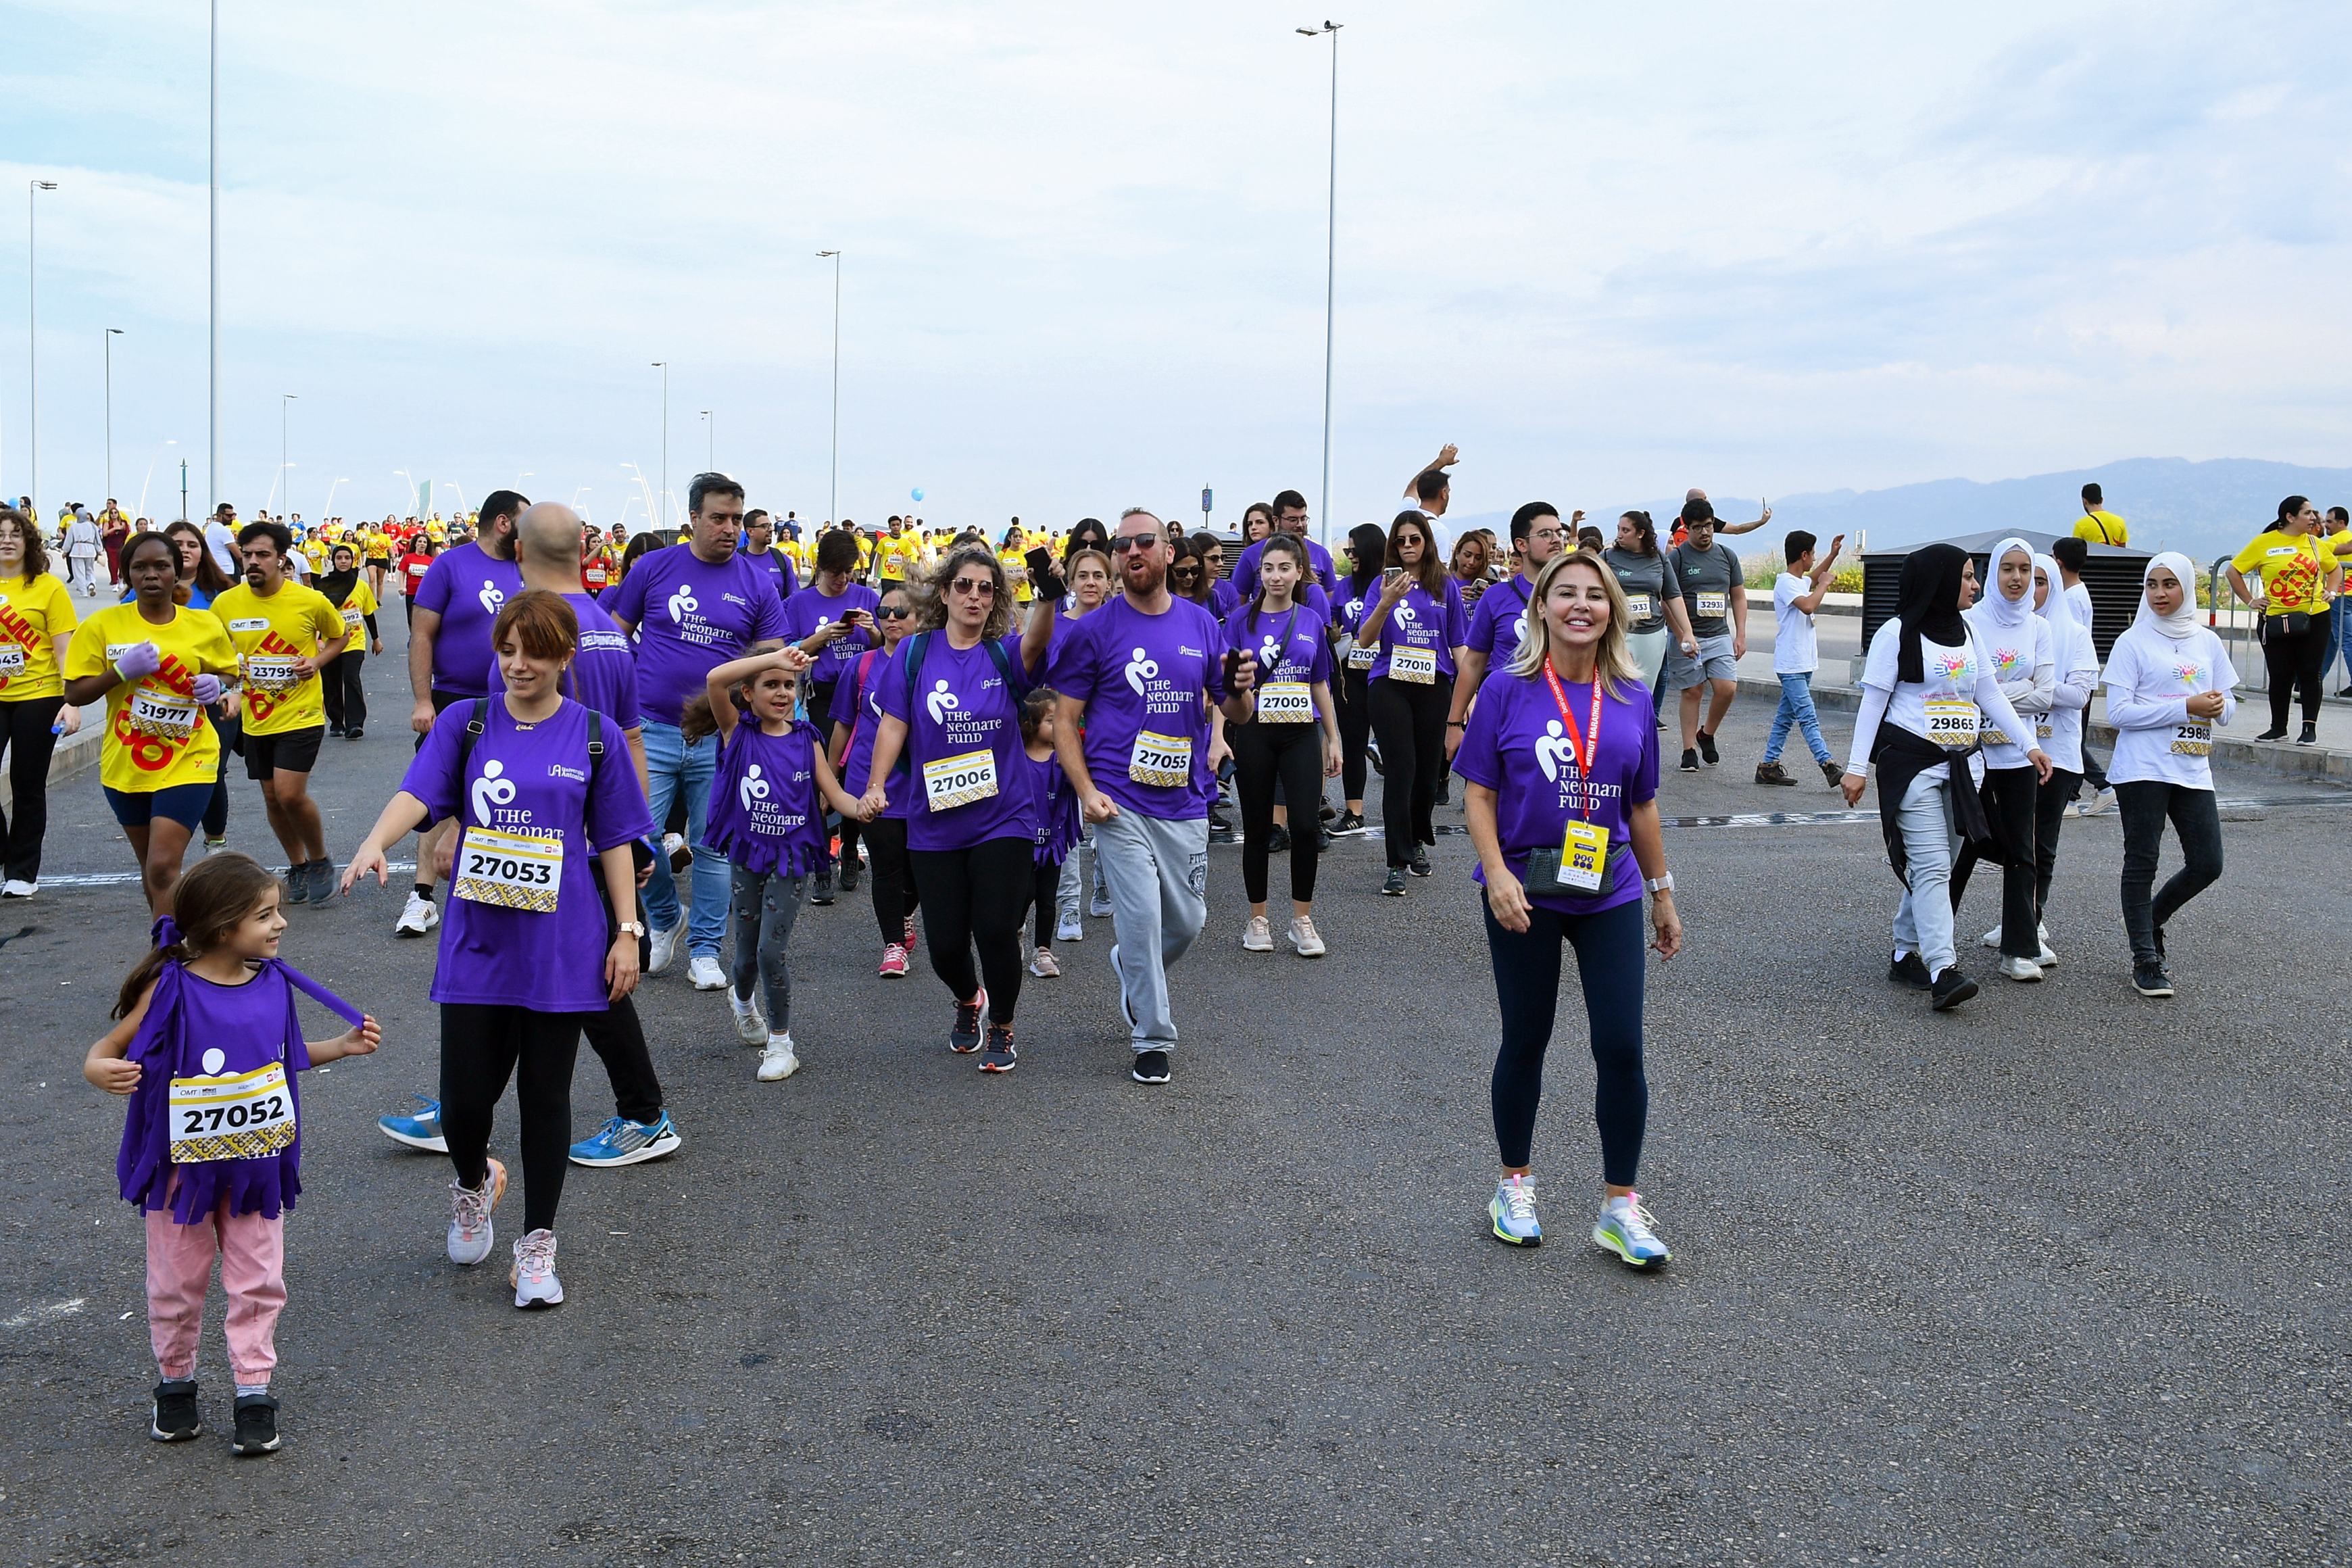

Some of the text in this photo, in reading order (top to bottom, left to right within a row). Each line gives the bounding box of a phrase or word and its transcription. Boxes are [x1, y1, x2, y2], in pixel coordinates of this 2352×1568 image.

[2283, 566, 2299, 581] SPIRIT
[107, 647, 128, 656] OMT
[1352, 650, 1377, 659] 2700
[253, 667, 293, 677] 23799
[1396, 658, 1431, 671] 27010
[1263, 697, 1308, 708] 27009
[139, 702, 189, 722] 31977
[1589, 700, 1600, 739] MARATHON
[1931, 718, 1974, 730] 29865
[2177, 726, 2211, 741] 29868
[1139, 750, 1187, 768] 27055
[1586, 739, 1596, 767] BEIRUT
[932, 768, 991, 793] 27006
[469, 854, 552, 884] 27053
[183, 1096, 285, 1134] 27052
